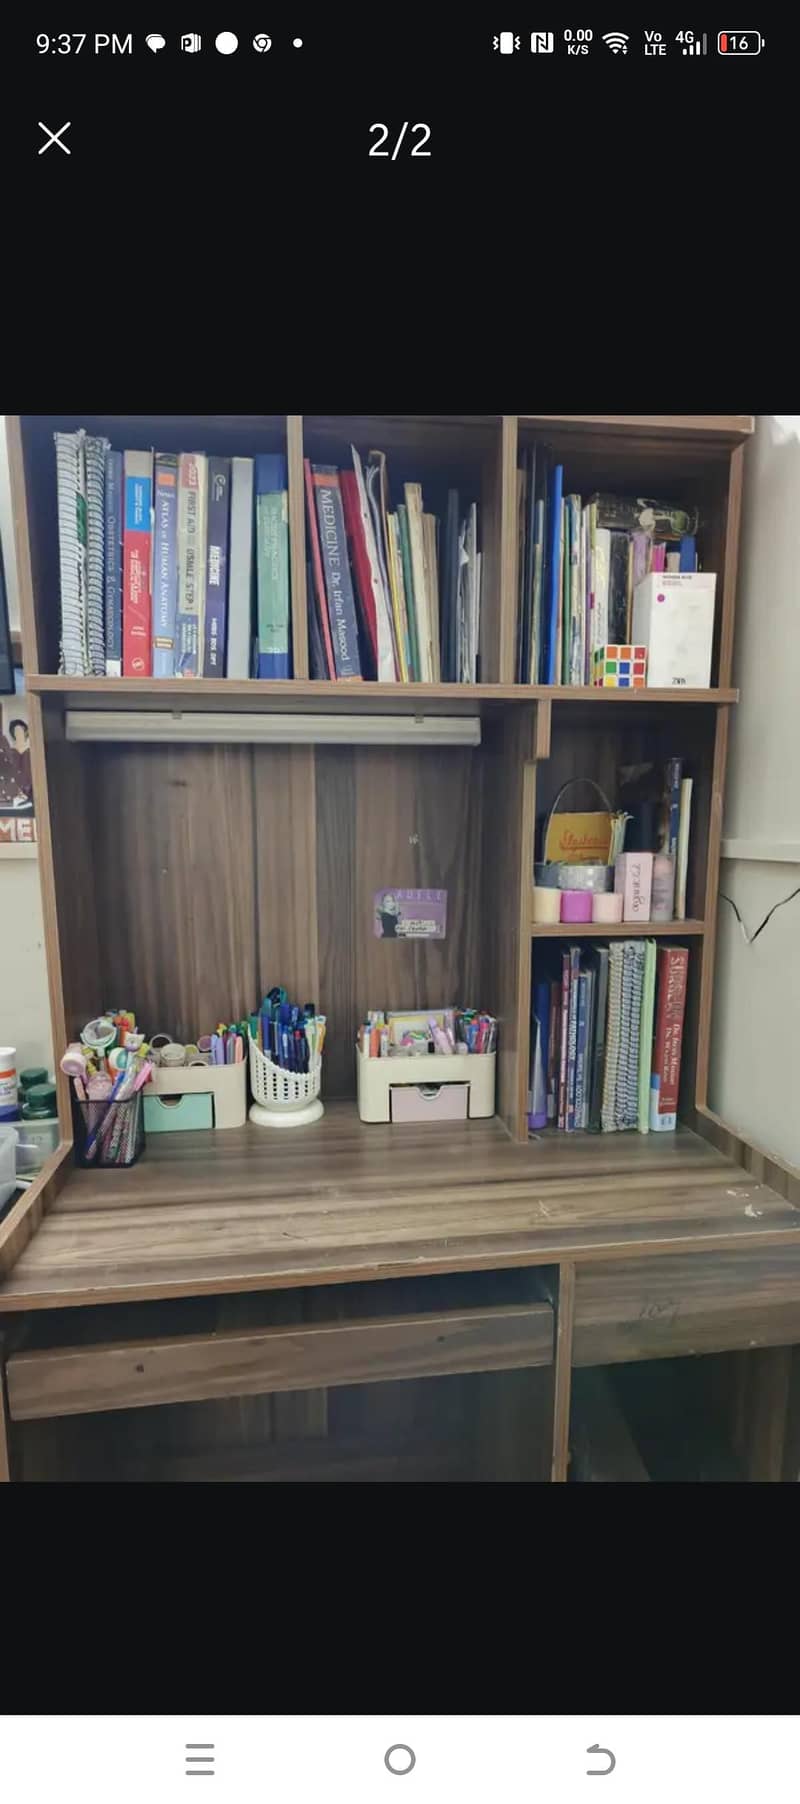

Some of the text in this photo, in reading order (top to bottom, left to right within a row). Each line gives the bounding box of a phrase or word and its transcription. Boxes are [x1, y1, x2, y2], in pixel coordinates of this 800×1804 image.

[161, 501, 170, 528] ATLAS
[187, 491, 196, 515] FIRST
[187, 517, 196, 534] AID
[160, 542, 169, 579] HUMAN
[319, 489, 351, 661] MEDICINE Dr. Irfan Masood
[159, 582, 168, 628] ANATOMY
[185, 583, 194, 604] STEP
